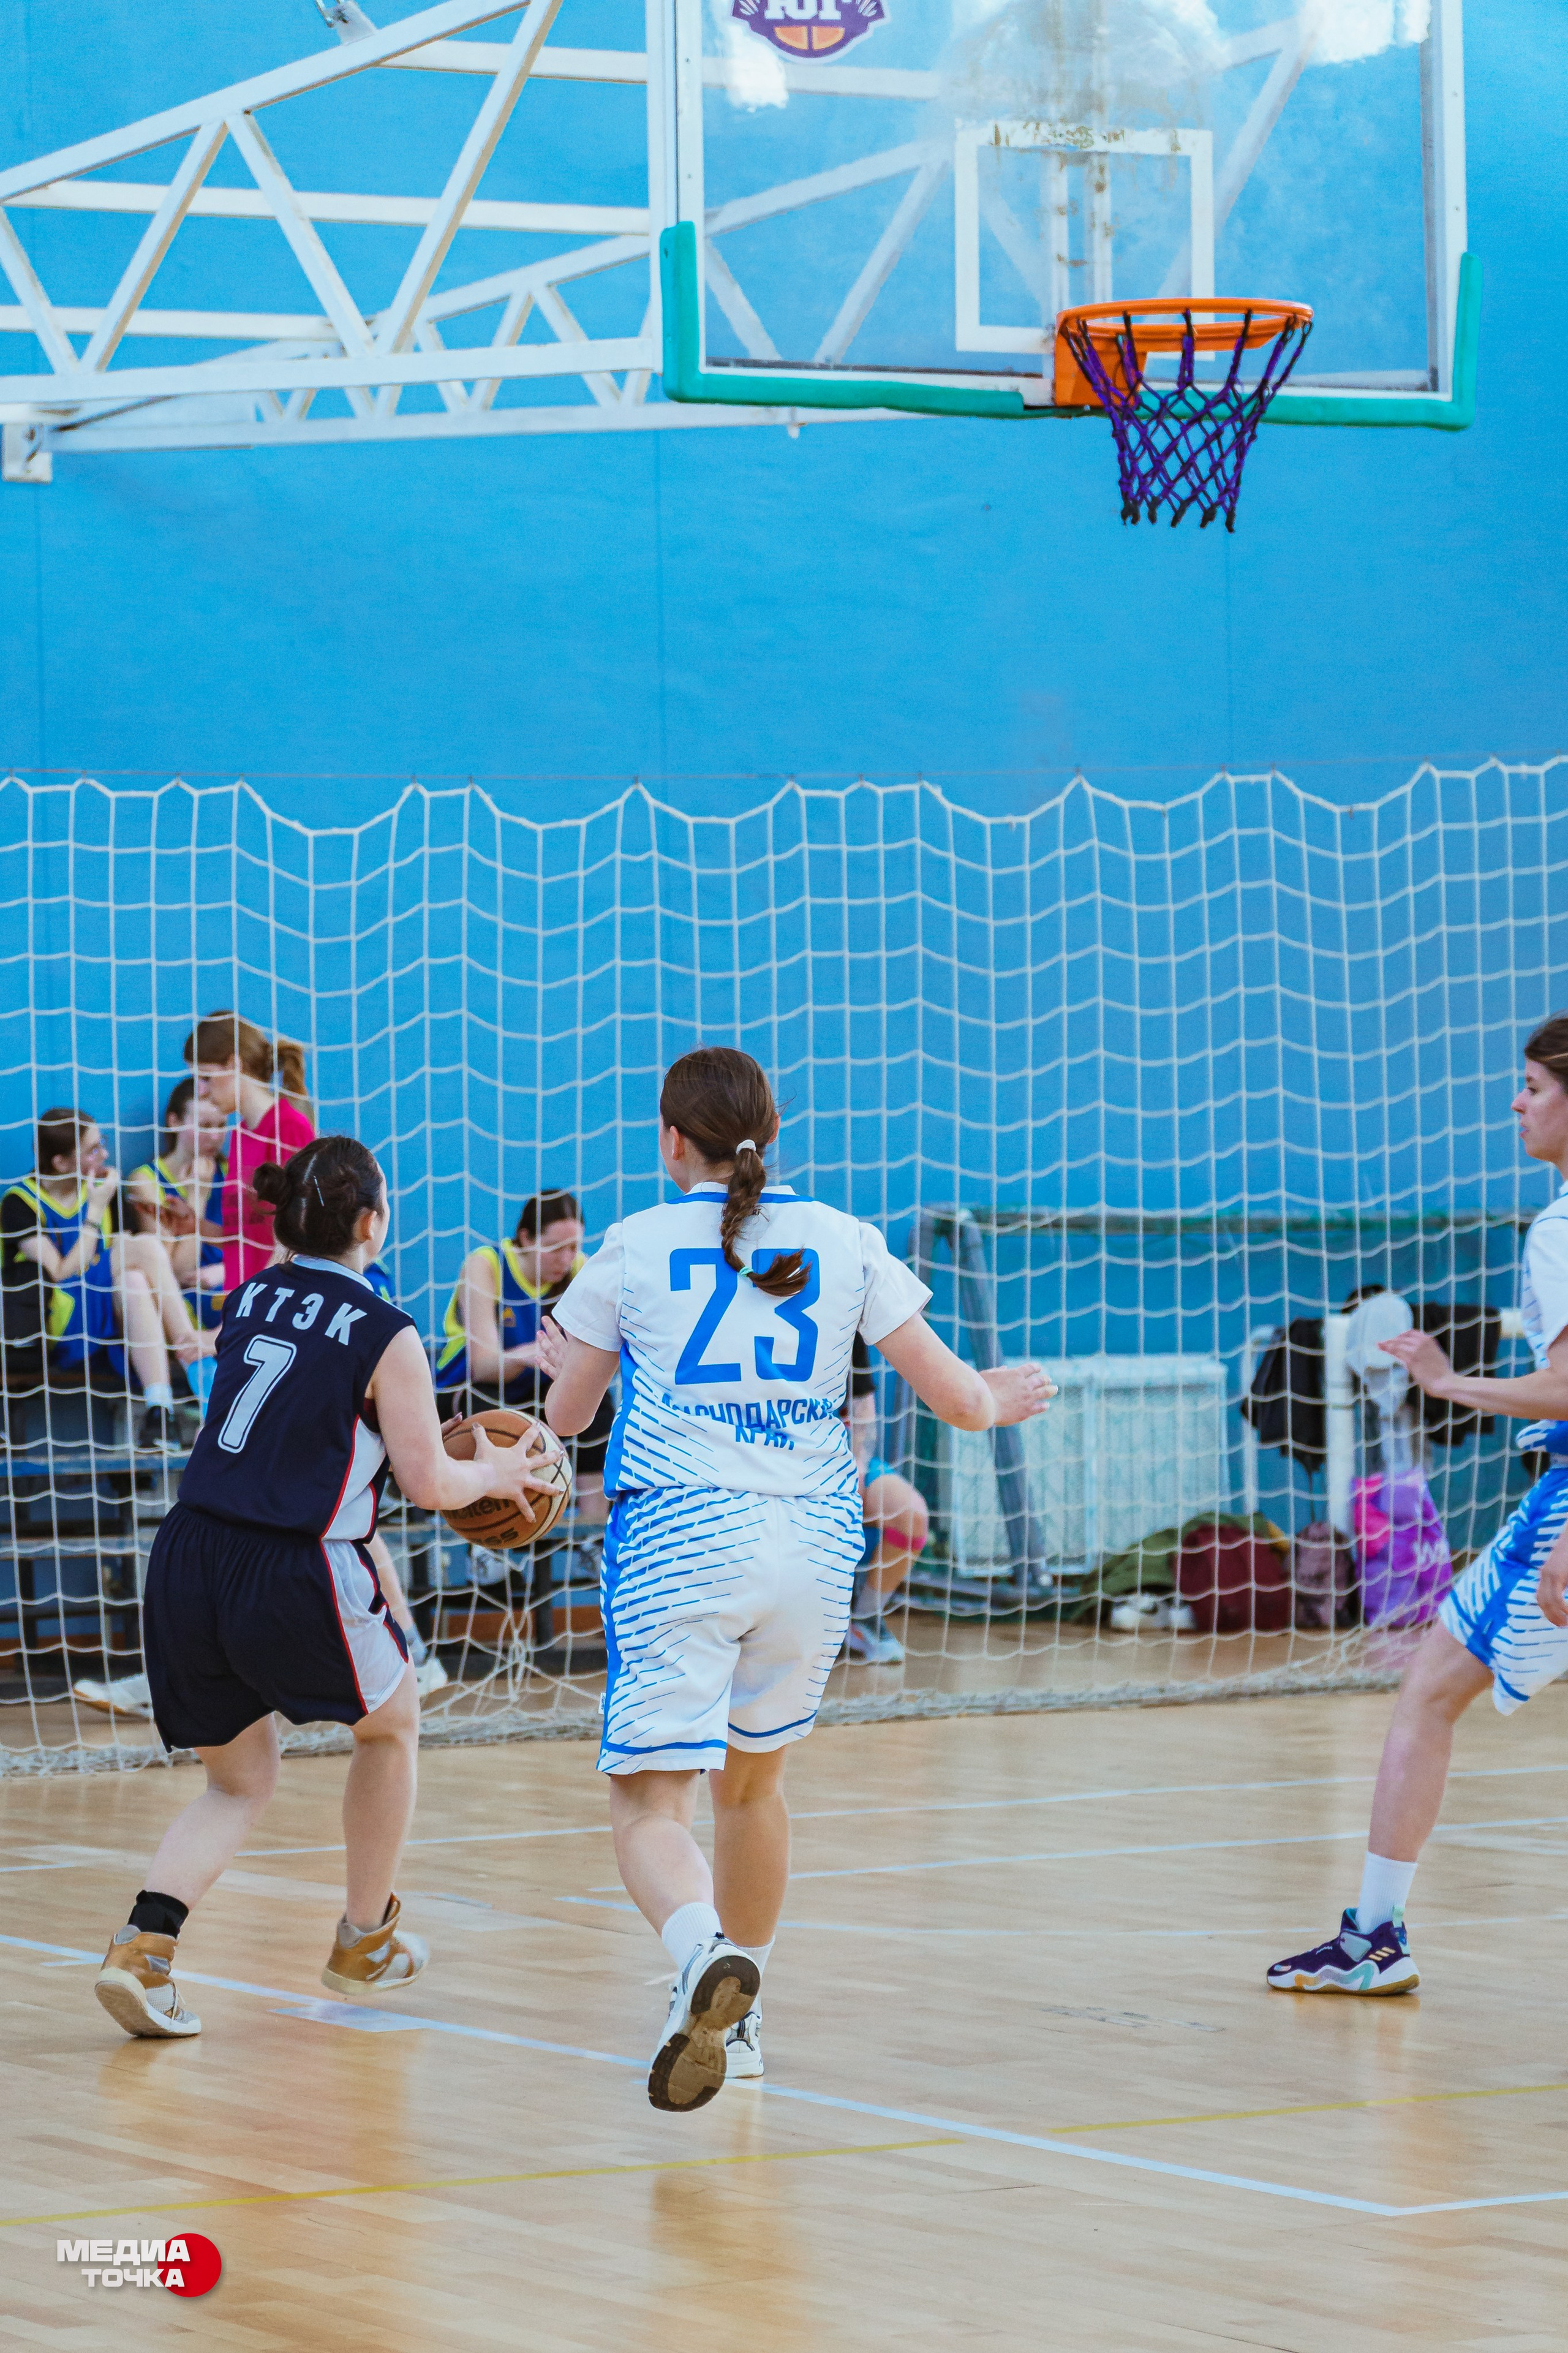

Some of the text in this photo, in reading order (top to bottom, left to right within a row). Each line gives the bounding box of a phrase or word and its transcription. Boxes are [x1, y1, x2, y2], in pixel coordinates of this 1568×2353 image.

[236, 1282, 368, 1345] КТЭК
[669, 1248, 820, 1385] 23
[218, 1334, 297, 1454] 7
